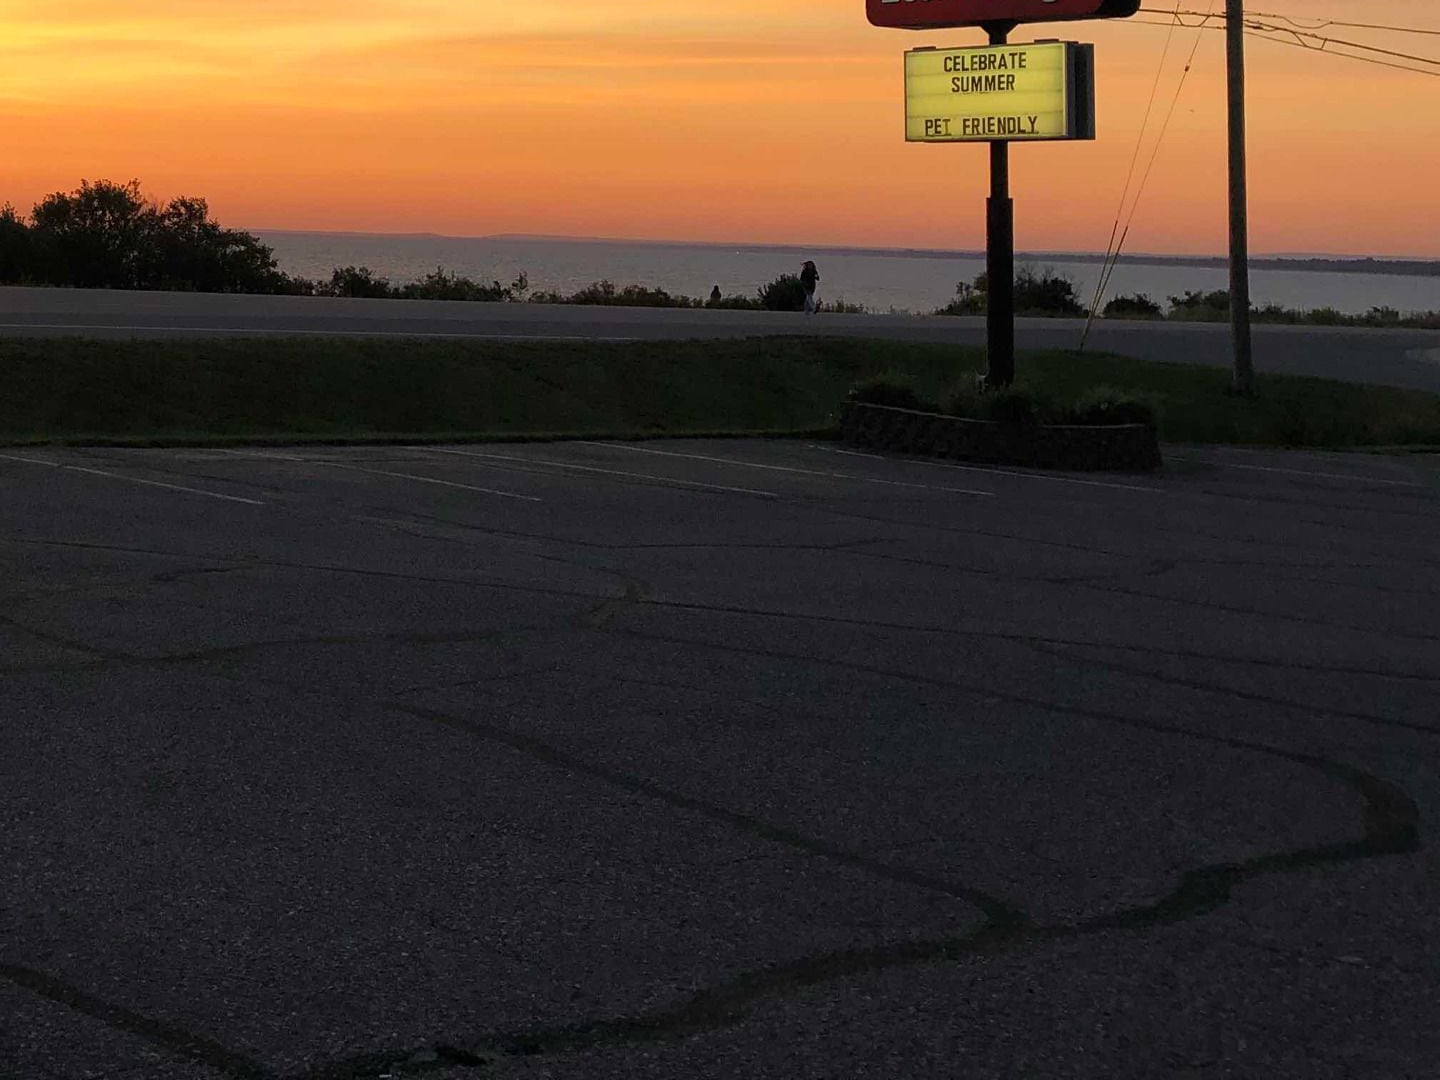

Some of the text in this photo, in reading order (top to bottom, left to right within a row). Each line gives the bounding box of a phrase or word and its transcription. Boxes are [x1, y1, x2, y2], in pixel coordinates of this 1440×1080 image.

[944, 52, 1027, 73] CELEBRATE
[951, 74, 1016, 93] SUMMER
[925, 116, 1039, 136] PET FRIENDLY
